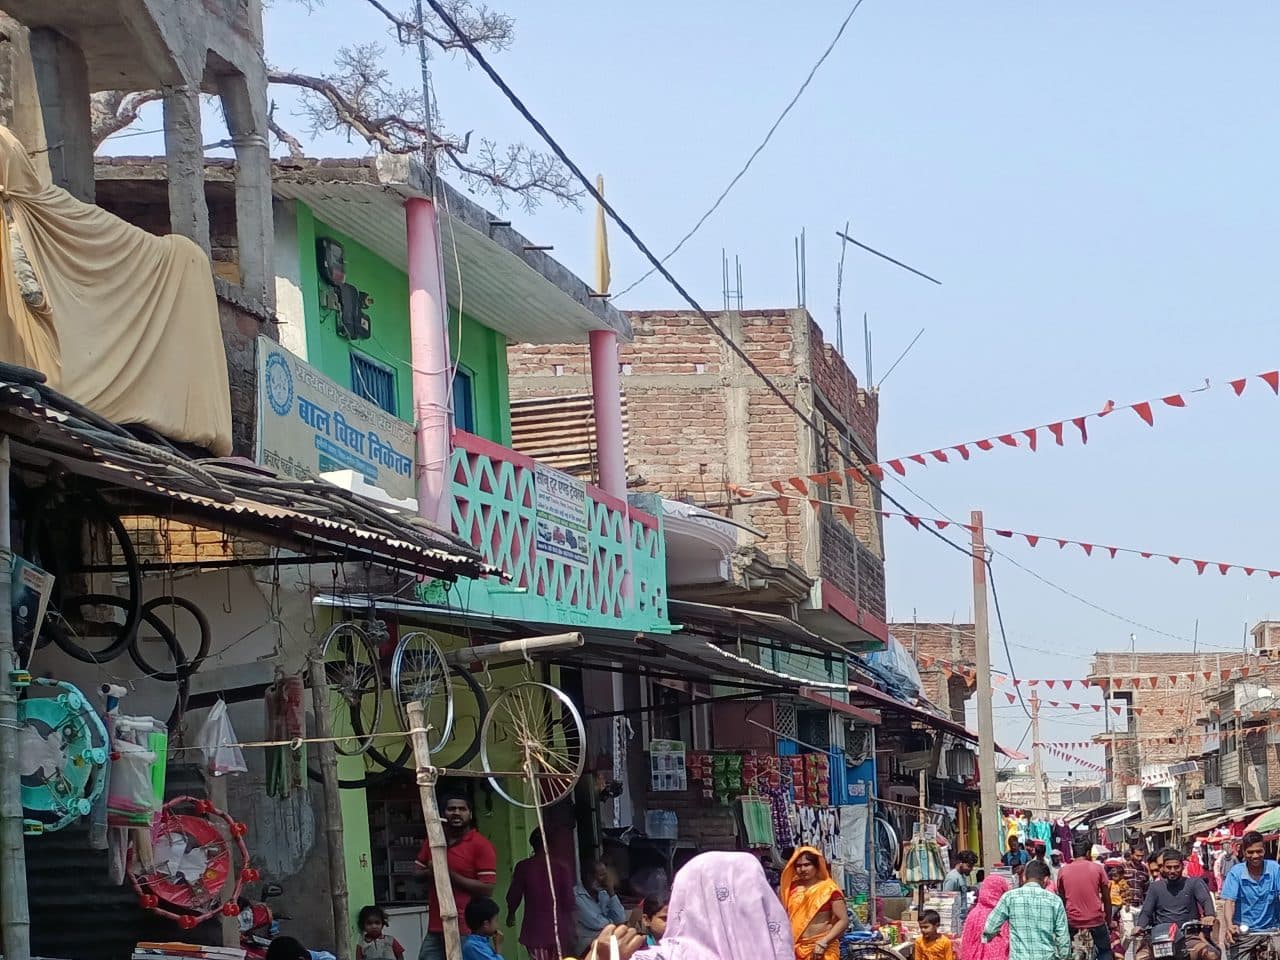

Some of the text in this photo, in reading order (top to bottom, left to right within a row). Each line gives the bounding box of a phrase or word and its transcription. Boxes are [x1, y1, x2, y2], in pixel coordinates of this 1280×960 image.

[297, 395, 331, 436] बाल
[333, 411, 365, 455] विद्या
[367, 431, 413, 478] निकेतन
